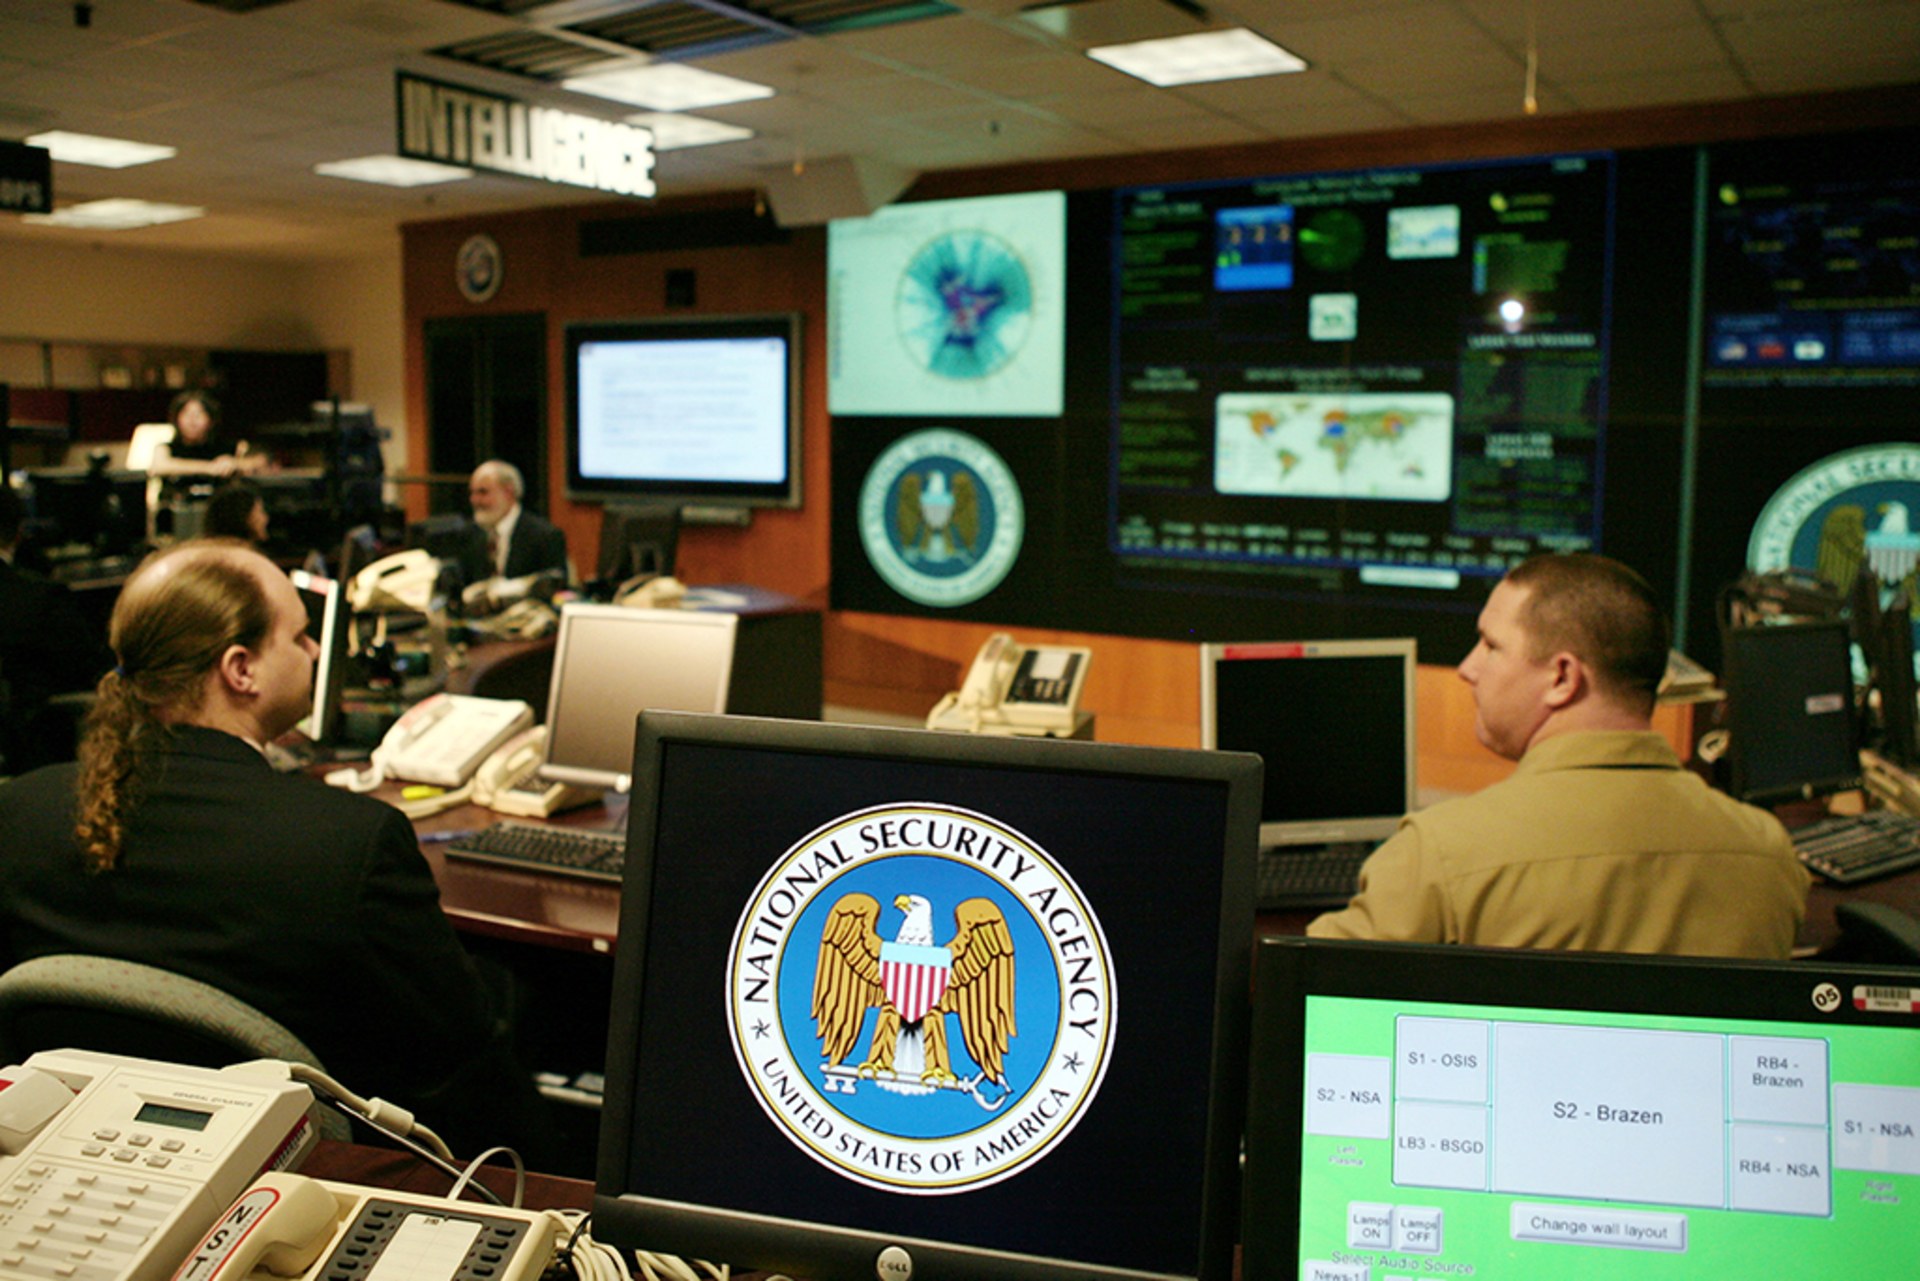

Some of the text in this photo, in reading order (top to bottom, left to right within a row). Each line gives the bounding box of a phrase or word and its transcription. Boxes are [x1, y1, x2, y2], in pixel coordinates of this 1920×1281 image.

[402, 78, 656, 198] INTELLIGENCE
[744, 818, 1100, 1039] NATIONAL SECURITY AGENCY
[1815, 987, 1838, 1007] 05
[1408, 1052, 1426, 1065] S1
[1441, 1053, 1478, 1068] OSIS
[1757, 1056, 1789, 1070] RB4
[1752, 1073, 1804, 1088] Brazen
[1316, 1088, 1336, 1102] S2
[1350, 1090, 1382, 1105] NSA
[763, 1057, 1070, 1175] UNITED STATES OF AMERICA
[1553, 1101, 1578, 1119] S2
[1597, 1104, 1663, 1125] Brazen
[1844, 1120, 1863, 1134] S1
[1880, 1123, 1914, 1137] NSA
[1399, 1136, 1426, 1150] LB3
[1440, 1140, 1484, 1154] BSGD
[1739, 1160, 1771, 1174] RB4
[1787, 1164, 1820, 1178] NSA
[1353, 1214, 1390, 1227] Lamps
[1401, 1217, 1437, 1231] Lamps
[1530, 1216, 1669, 1241] Change wall layout
[1362, 1227, 1381, 1239] ON
[1406, 1231, 1431, 1242] OFF
[1332, 1252, 1474, 1275] Select Audio Source
